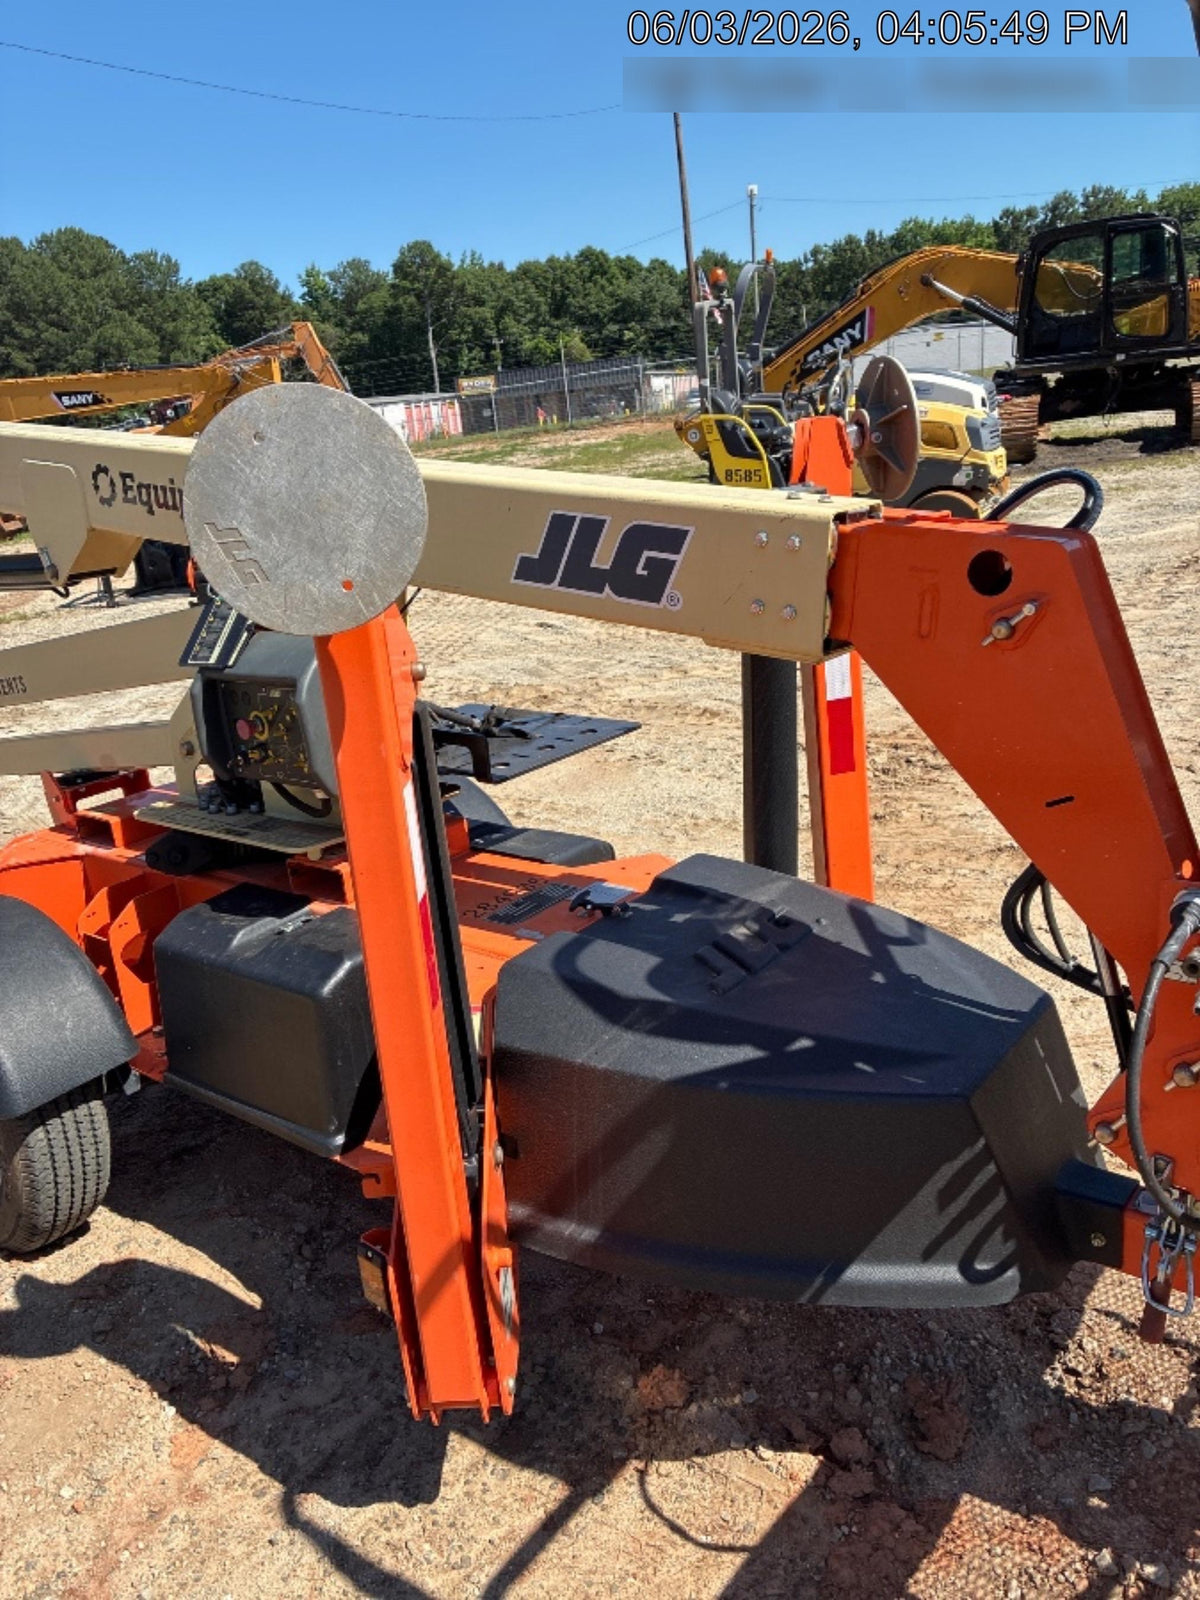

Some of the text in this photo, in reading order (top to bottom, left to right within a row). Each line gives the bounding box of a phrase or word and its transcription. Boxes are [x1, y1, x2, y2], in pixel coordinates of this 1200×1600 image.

[61, 393, 94, 406] SANY
[724, 468, 762, 483] 8585
[203, 522, 271, 590] JLG
[0, 675, 28, 696] ENTS
